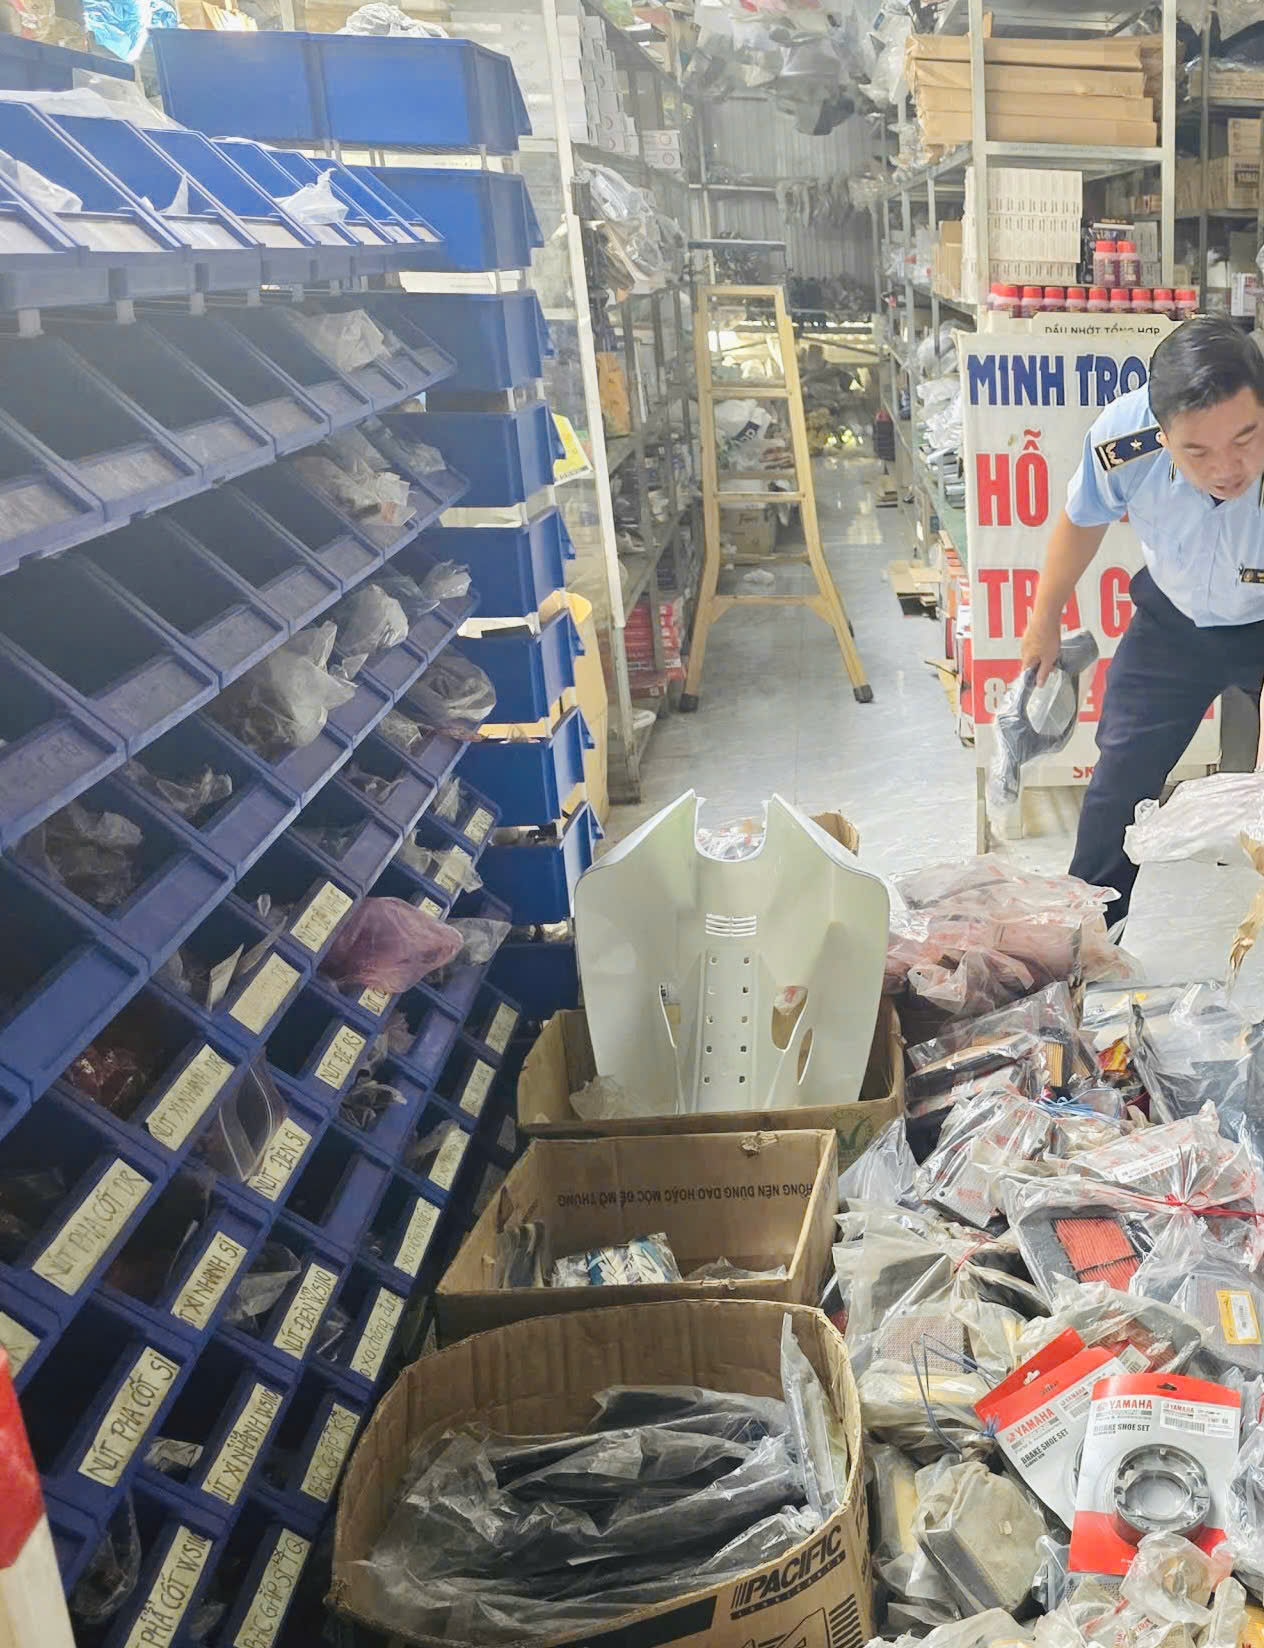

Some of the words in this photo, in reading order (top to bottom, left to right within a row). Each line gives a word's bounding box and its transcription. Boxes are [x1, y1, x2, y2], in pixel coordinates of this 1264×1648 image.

[967, 354, 1065, 406] MINH
[976, 428, 1049, 527] HỖ
[317, 1059, 343, 1083] NÚT
[342, 1032, 361, 1049] RS
[700, 1187, 722, 1200] DAO
[724, 1185, 755, 1200] DÙNG
[757, 1184, 780, 1199] NÊN
[37, 1243, 80, 1285] NÚT
[112, 1165, 143, 1195] DR
[192, 1255, 229, 1299] NHANH
[288, 1301, 318, 1332] ĐÈN
[276, 1325, 307, 1357] NÚT
[123, 1372, 161, 1407] CỐT
[1111, 1399, 1152, 1410] YAMAHA
[109, 1405, 146, 1440] PHA
[1014, 1408, 1055, 1437] YAMAHA
[1117, 1423, 1136, 1431] SHOE
[1137, 1424, 1150, 1432] SET
[85, 1439, 127, 1479] NÚT
[1020, 1446, 1042, 1465] BRAKE
[1040, 1435, 1058, 1451] SHOE
[1057, 1428, 1069, 1440] SET
[746, 1525, 842, 1605] PACIFIC
[150, 1567, 193, 1611] CỐT
